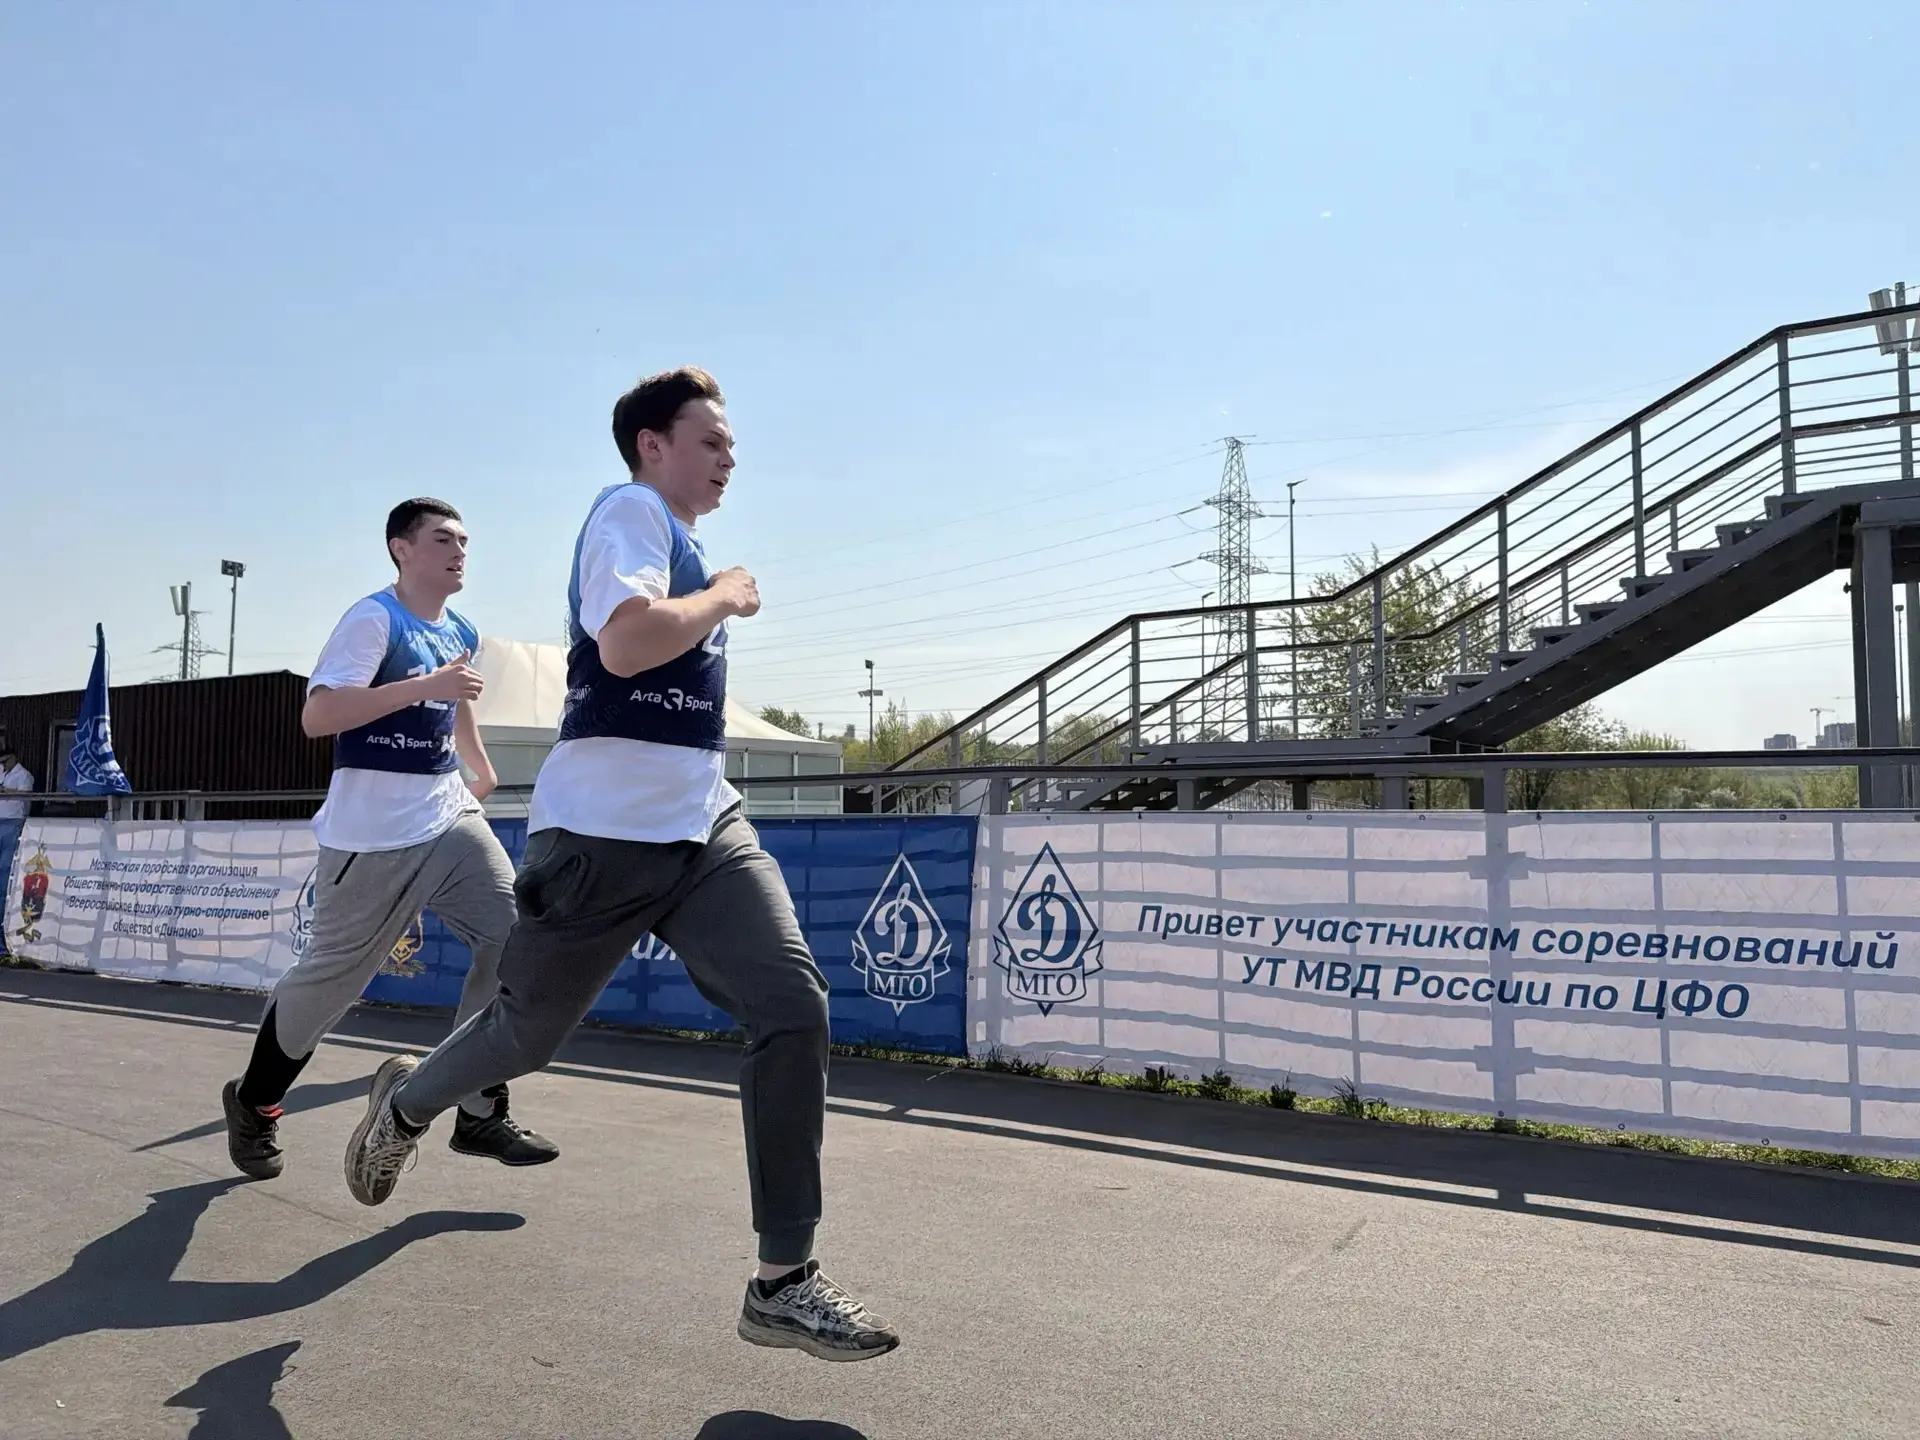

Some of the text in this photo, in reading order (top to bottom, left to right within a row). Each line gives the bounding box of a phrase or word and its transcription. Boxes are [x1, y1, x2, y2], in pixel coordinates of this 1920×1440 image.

[630, 689, 713, 711] Arta Sport
[366, 735, 390, 744] Arta
[406, 738, 433, 749] Sport
[90, 858, 258, 878] Московская городская организация
[64, 876, 281, 899] Общественно-государственного объединения
[133, 902, 269, 921] физкультурно-спортивное
[113, 919, 204, 939] общество «Динамо»
[1137, 905, 1898, 969] Привет участникам соревнований
[872, 972, 928, 997] МГО
[1015, 970, 1077, 996] МГО
[1241, 956, 1750, 1019] УТ МВД России по ЦФО
